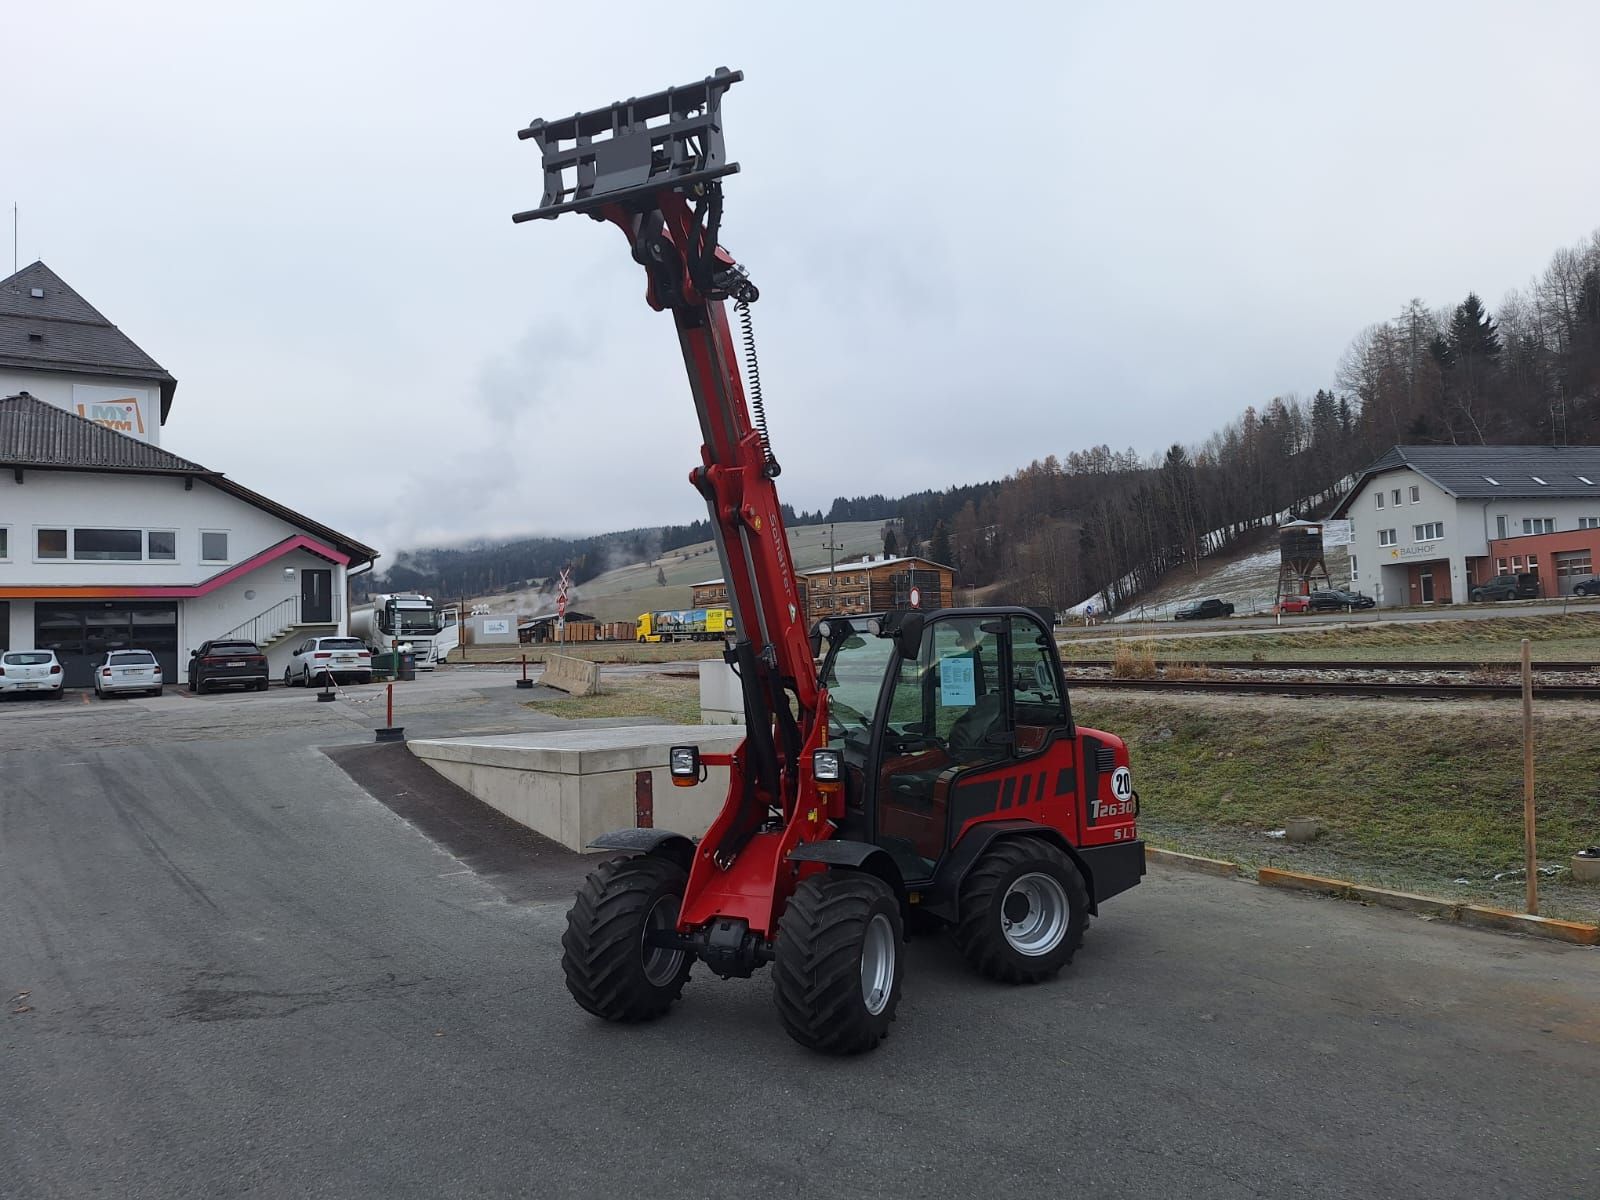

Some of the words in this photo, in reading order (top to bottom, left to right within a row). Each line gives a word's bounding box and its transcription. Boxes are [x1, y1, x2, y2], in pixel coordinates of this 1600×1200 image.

[92, 405, 128, 420] MY
[94, 419, 132, 432] YM
[1400, 544, 1436, 556] BAUHOF
[1116, 773, 1130, 795] 20
[1090, 799, 1133, 819] T2630
[1114, 827, 1136, 840] SLT
